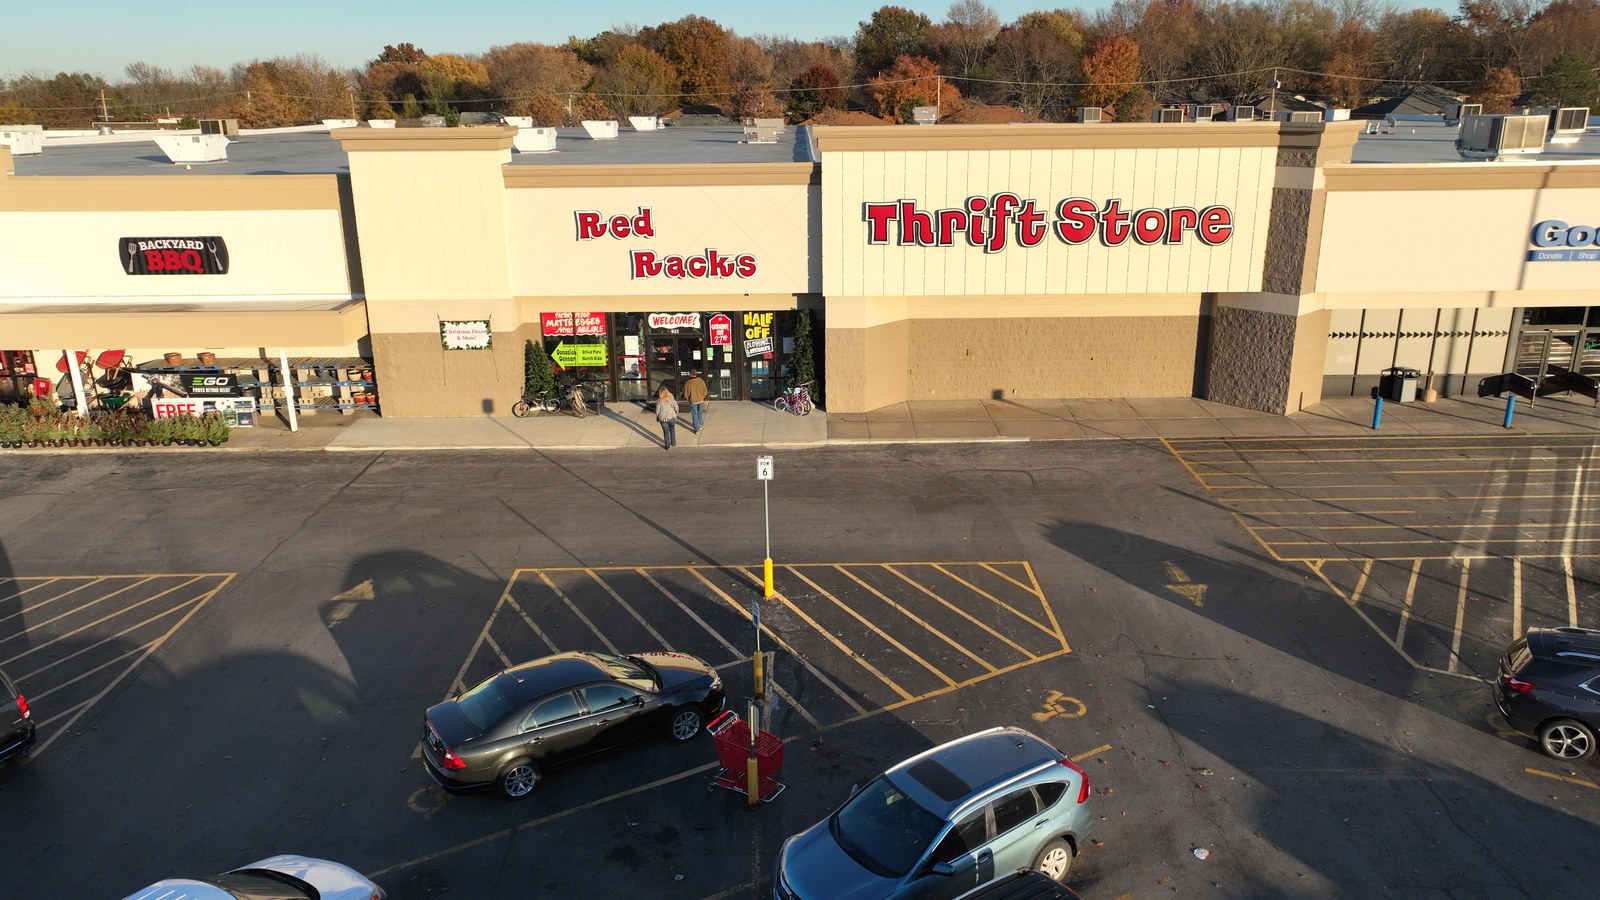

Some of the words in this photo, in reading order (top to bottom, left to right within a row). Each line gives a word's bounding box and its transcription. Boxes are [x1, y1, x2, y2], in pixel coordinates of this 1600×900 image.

[574, 206, 656, 241] Red
[862, 192, 1049, 254] Thrift
[1054, 196, 1234, 247] Store
[138, 239, 204, 251] BACKYARD
[144, 249, 204, 273] BBQ
[1538, 252, 1563, 260] Donate
[1577, 252, 1597, 261] Shop
[629, 248, 757, 280] Racks
[545, 317, 601, 328] MATTRESSES
[652, 315, 698, 326] WELCOME!
[743, 312, 773, 328] HALF
[745, 326, 770, 340] OFF
[192, 377, 229, 386] EGO
[156, 403, 196, 419] FREE
[763, 468, 768, 476] 6
